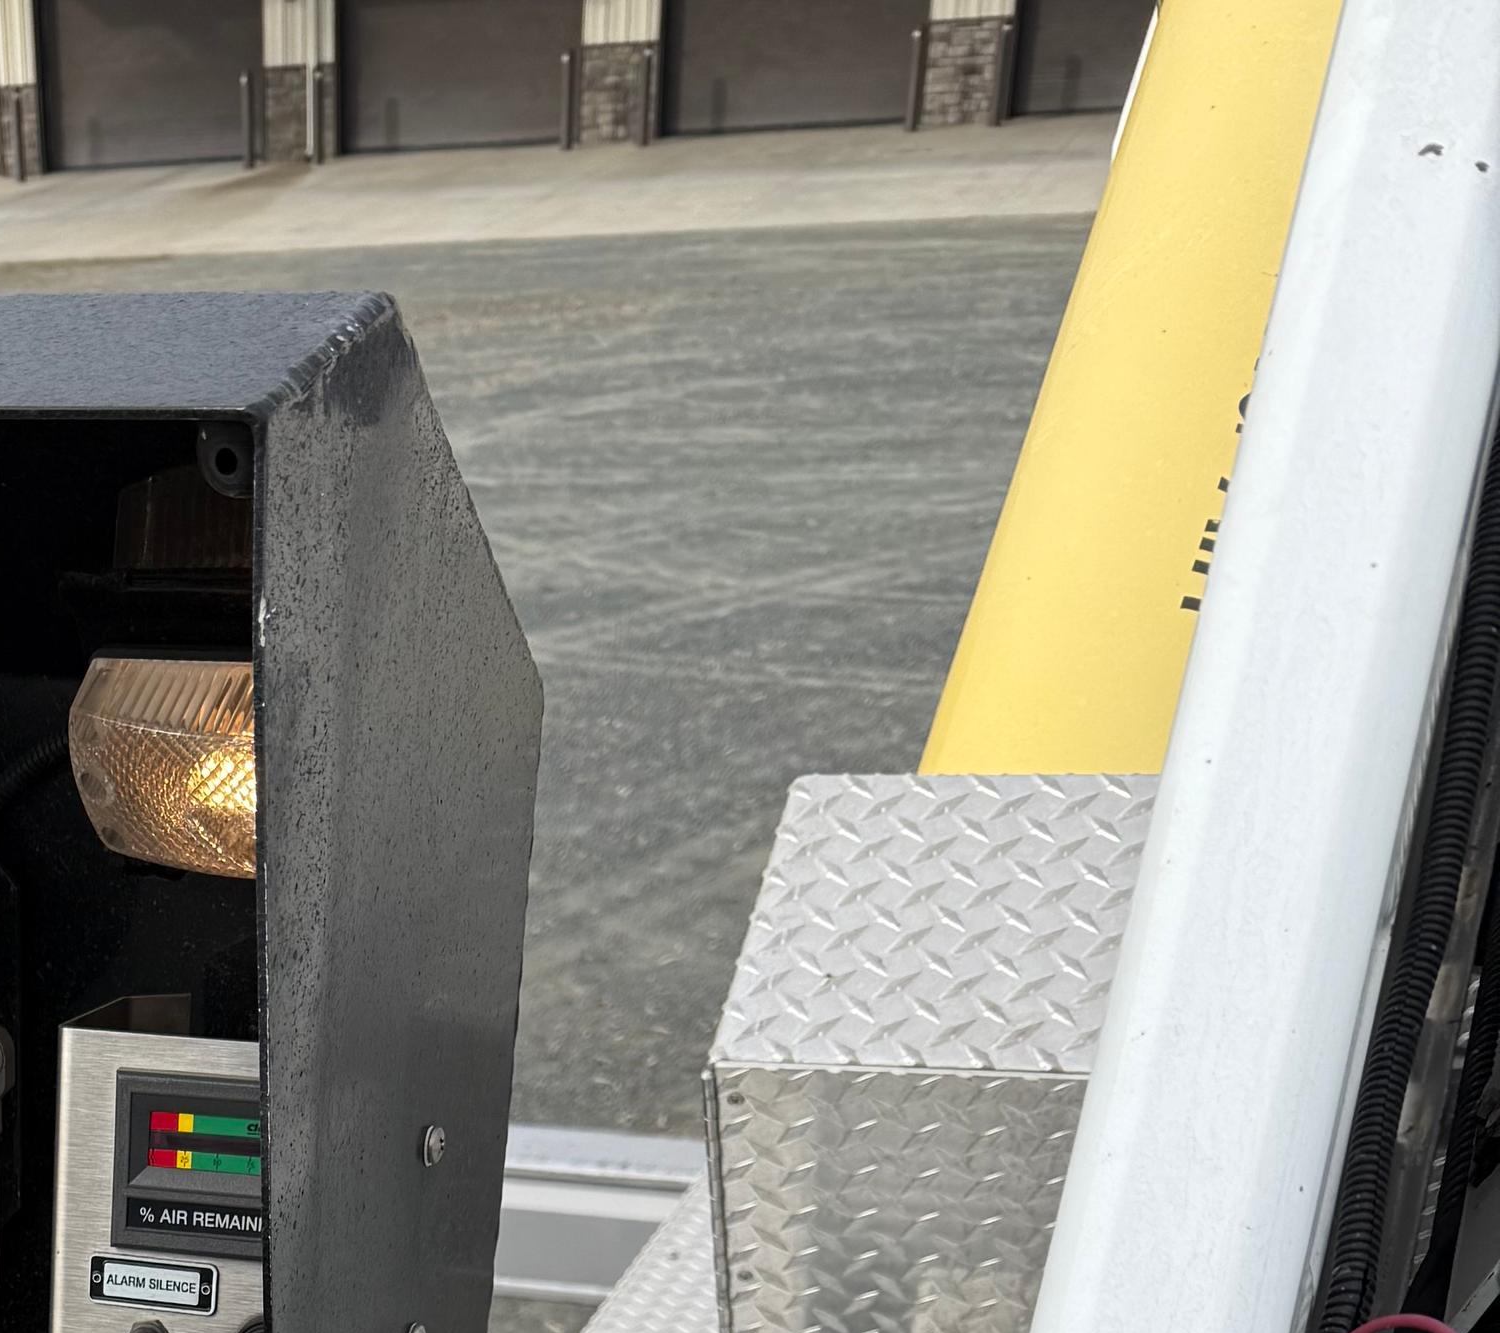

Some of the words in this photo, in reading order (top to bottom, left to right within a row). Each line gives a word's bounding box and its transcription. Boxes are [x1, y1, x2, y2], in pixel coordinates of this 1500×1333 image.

[139, 1207, 155, 1222] %
[160, 1209, 188, 1226] AIR
[193, 1211, 262, 1232] REMAINI
[106, 1273, 146, 1289] ALARM
[149, 1278, 197, 1294] SILENCE
